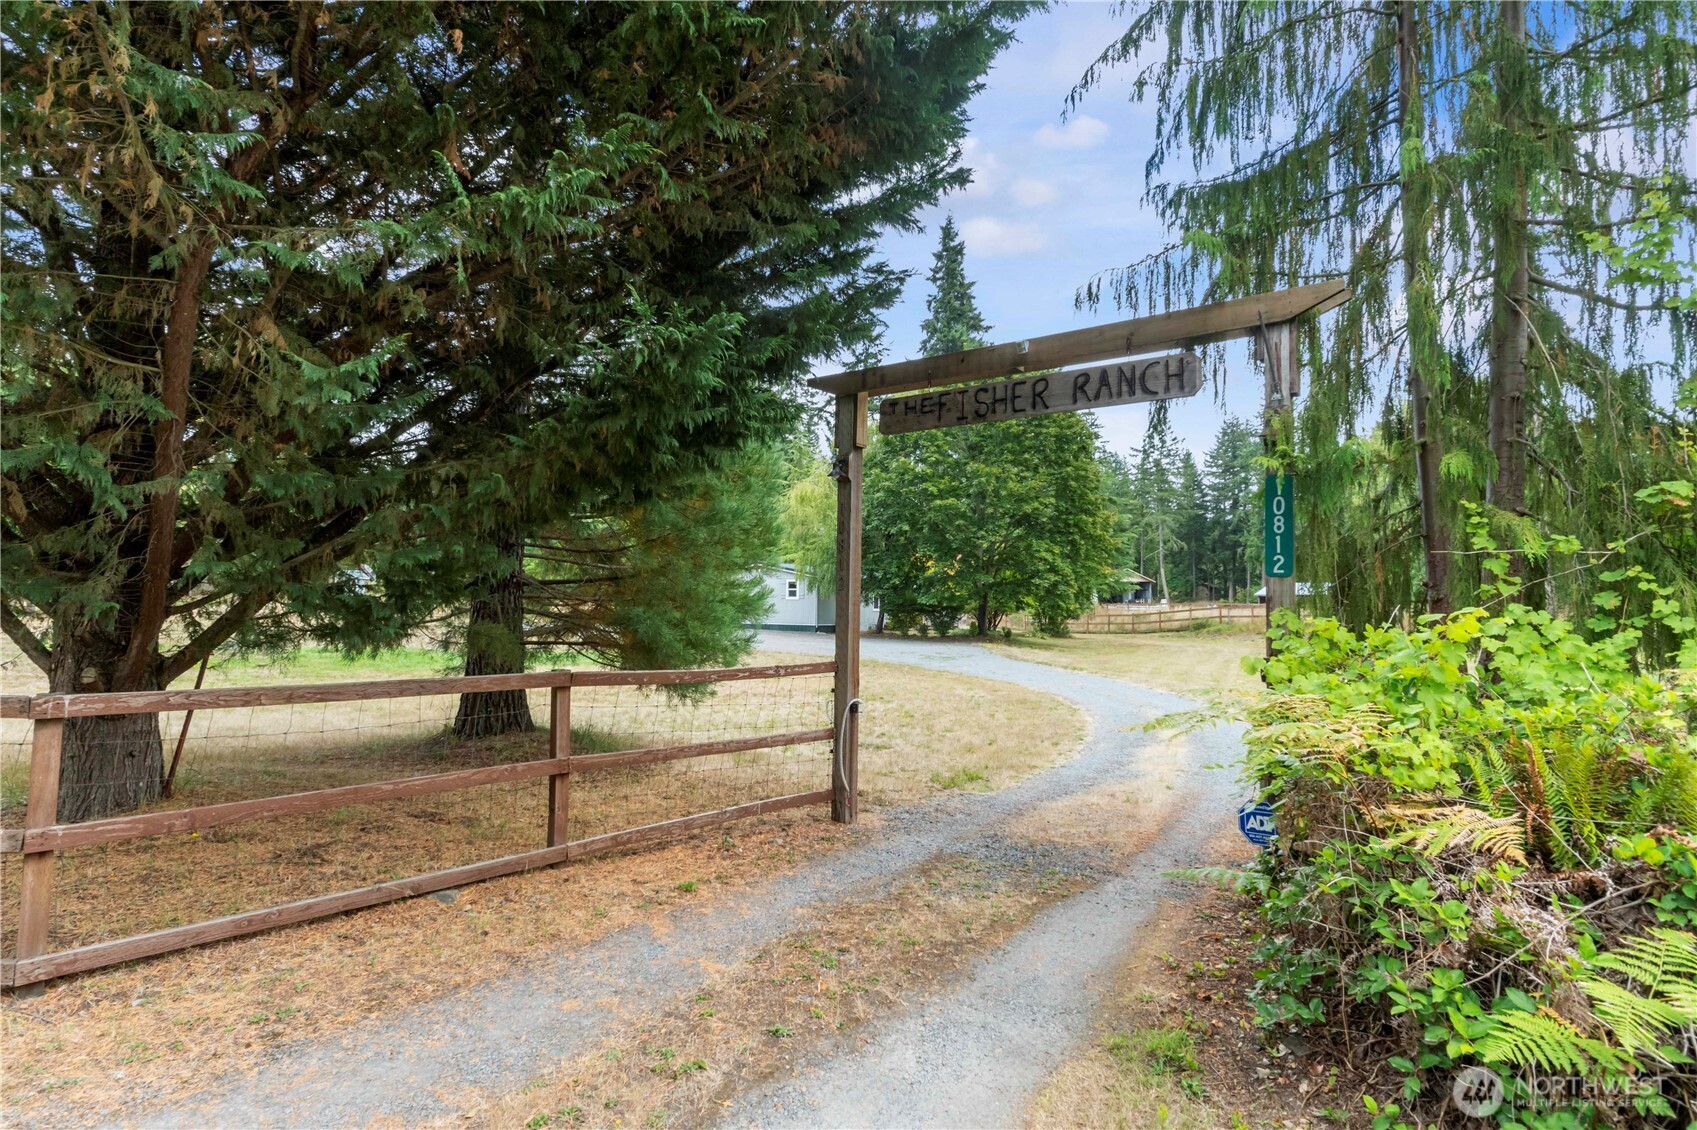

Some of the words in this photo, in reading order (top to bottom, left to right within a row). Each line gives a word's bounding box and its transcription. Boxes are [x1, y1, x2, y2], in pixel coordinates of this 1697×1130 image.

[890, 397, 934, 416] THE
[935, 377, 1050, 423] FISHER
[1072, 356, 1187, 405] RANCH
[1272, 476, 1286, 574] 0812
